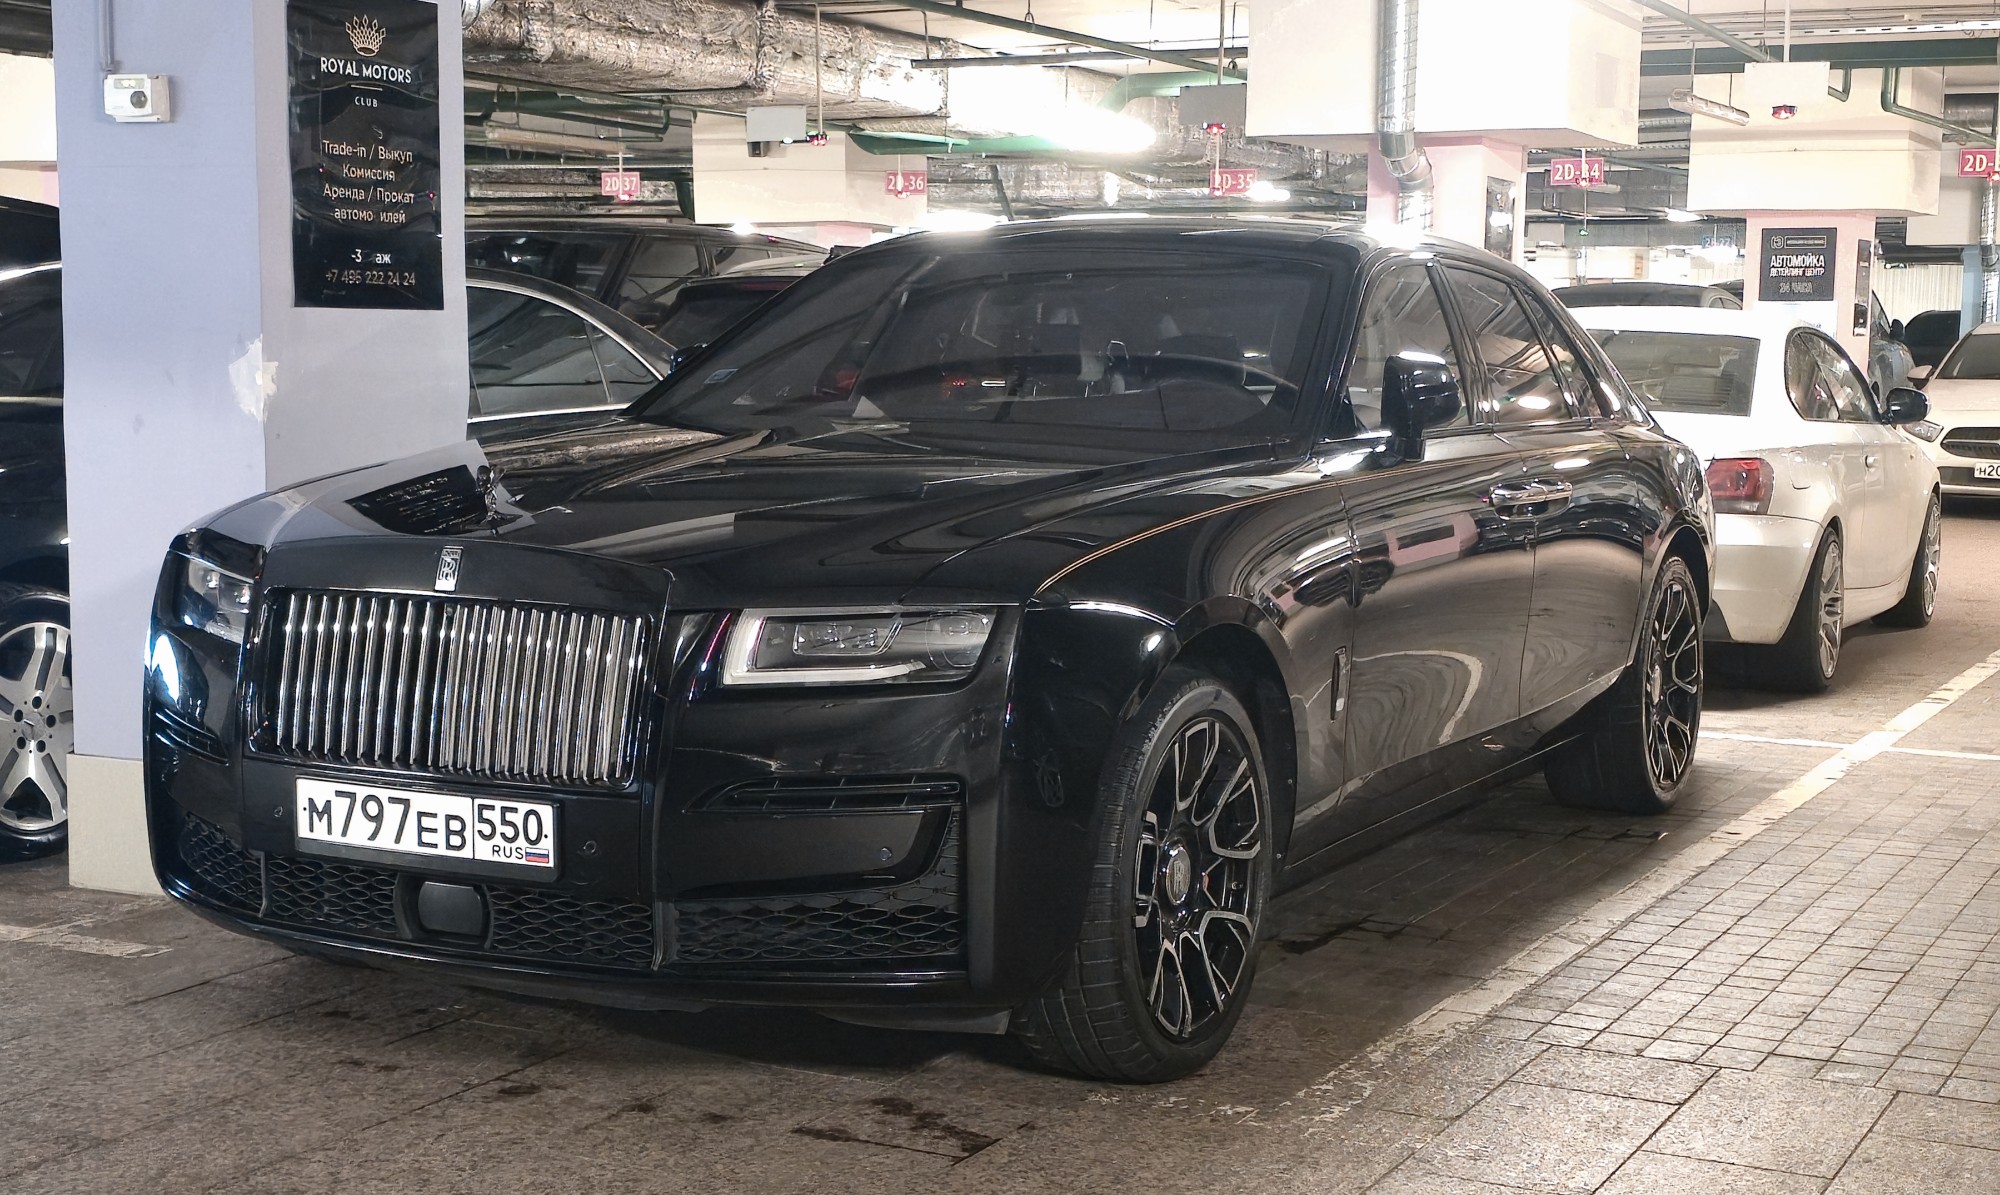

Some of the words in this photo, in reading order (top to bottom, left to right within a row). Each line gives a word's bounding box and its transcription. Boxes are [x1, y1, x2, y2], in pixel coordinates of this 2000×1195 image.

[320, 57, 359, 77] ROYAL
[362, 64, 412, 84] MOTORS
[354, 96, 378, 108] CLUB
[322, 140, 367, 158] Trade-in
[378, 145, 413, 164] Выкуп
[342, 163, 396, 182] Комиссия
[604, 176, 637, 192] 2D37
[323, 183, 365, 202] Аренда
[376, 188, 415, 204] Прокат
[334, 208, 406, 223] автомоилей
[351, 249, 362, 263] -3
[1770, 252, 1825, 268] АВТОМОЙКА
[365, 271, 385, 285] 222
[387, 272, 400, 285] 24
[403, 272, 416, 286] 24
[1804, 267, 1825, 277] ЦЕНТР
[477, 803, 544, 846] 550
[491, 844, 524, 860] RUS
